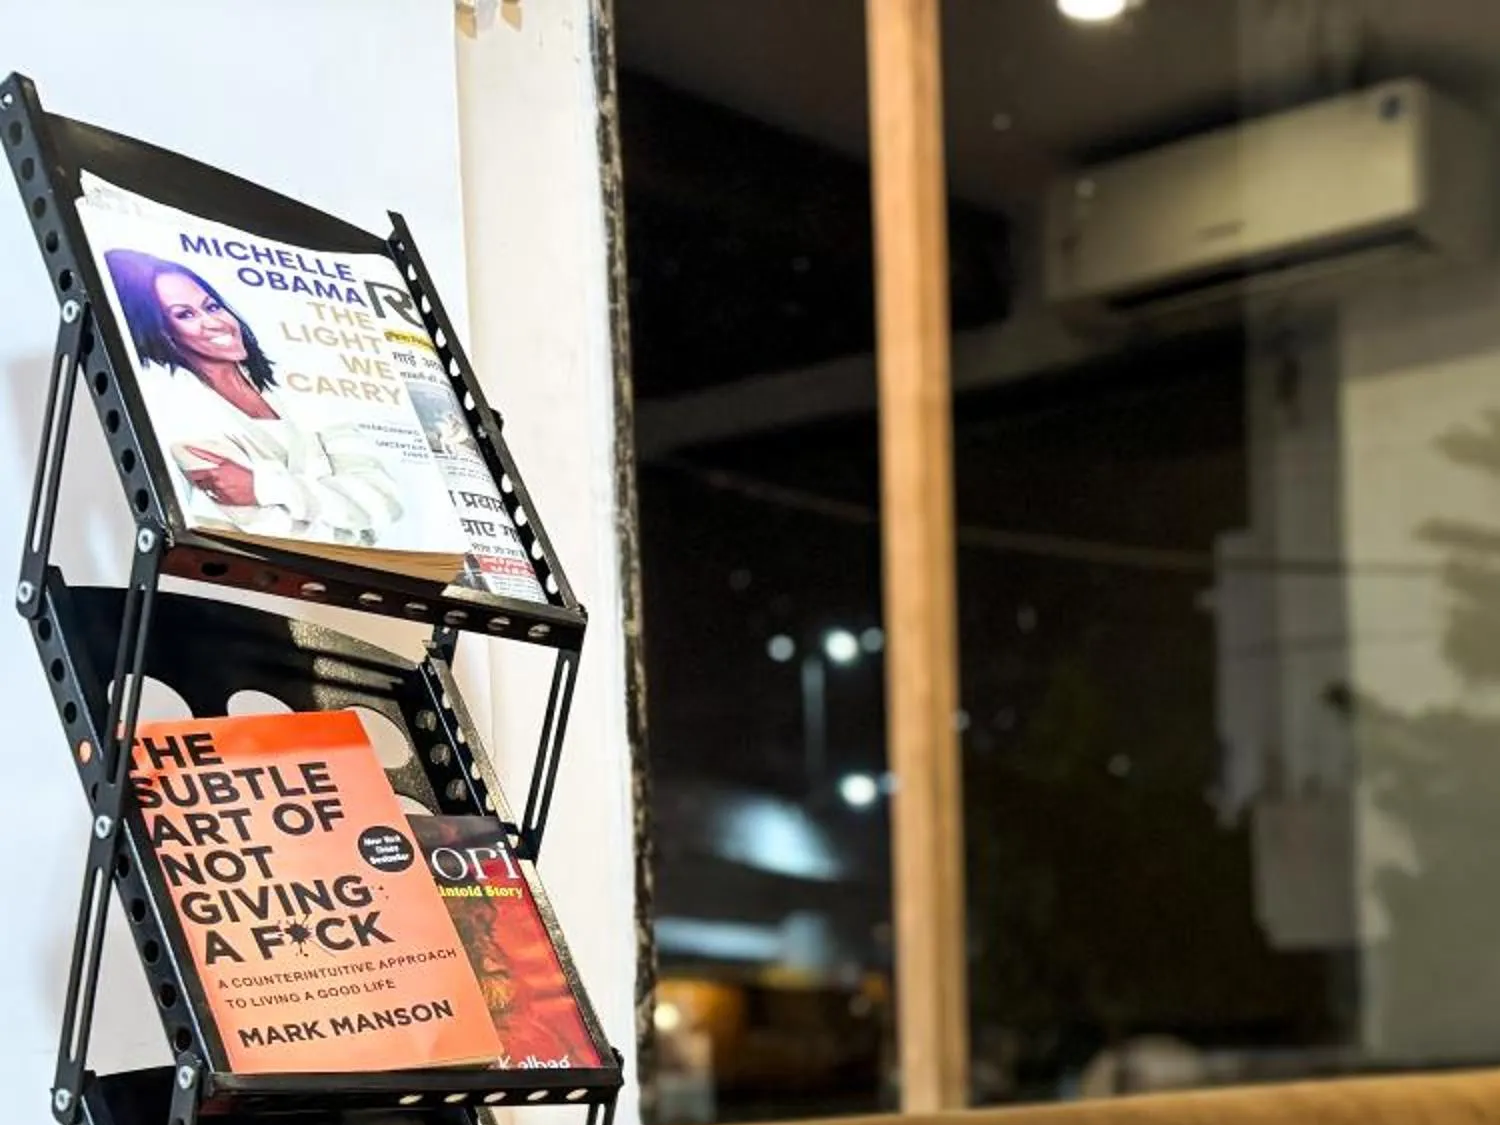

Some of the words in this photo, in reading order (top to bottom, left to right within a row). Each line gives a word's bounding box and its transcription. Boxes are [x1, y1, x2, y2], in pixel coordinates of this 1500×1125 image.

[180, 233, 357, 283] MICHELLE
[237, 268, 368, 307] OBAMA
[306, 301, 377, 330] THE
[281, 321, 384, 354] LIGHT
[340, 354, 396, 380] WE
[285, 373, 401, 405] CARRY
[130, 762, 338, 808] SUBTLE
[151, 808, 252, 848] ART
[272, 798, 345, 835] OF
[159, 846, 273, 886] NOT
[180, 875, 373, 924] GIVING
[484, 885, 523, 898] Story
[205, 930, 244, 965] A
[218, 979, 229, 989] A
[232, 961, 376, 988] COUNTERINTUITIVE
[379, 948, 457, 972] APPROACH
[225, 998, 247, 1009] TO
[250, 992, 301, 1007] LIVING
[304, 991, 316, 1001] A
[317, 984, 361, 998] GOOD
[364, 978, 396, 992] LIFE
[237, 1020, 327, 1048] MARK
[330, 999, 454, 1037] MANSON
